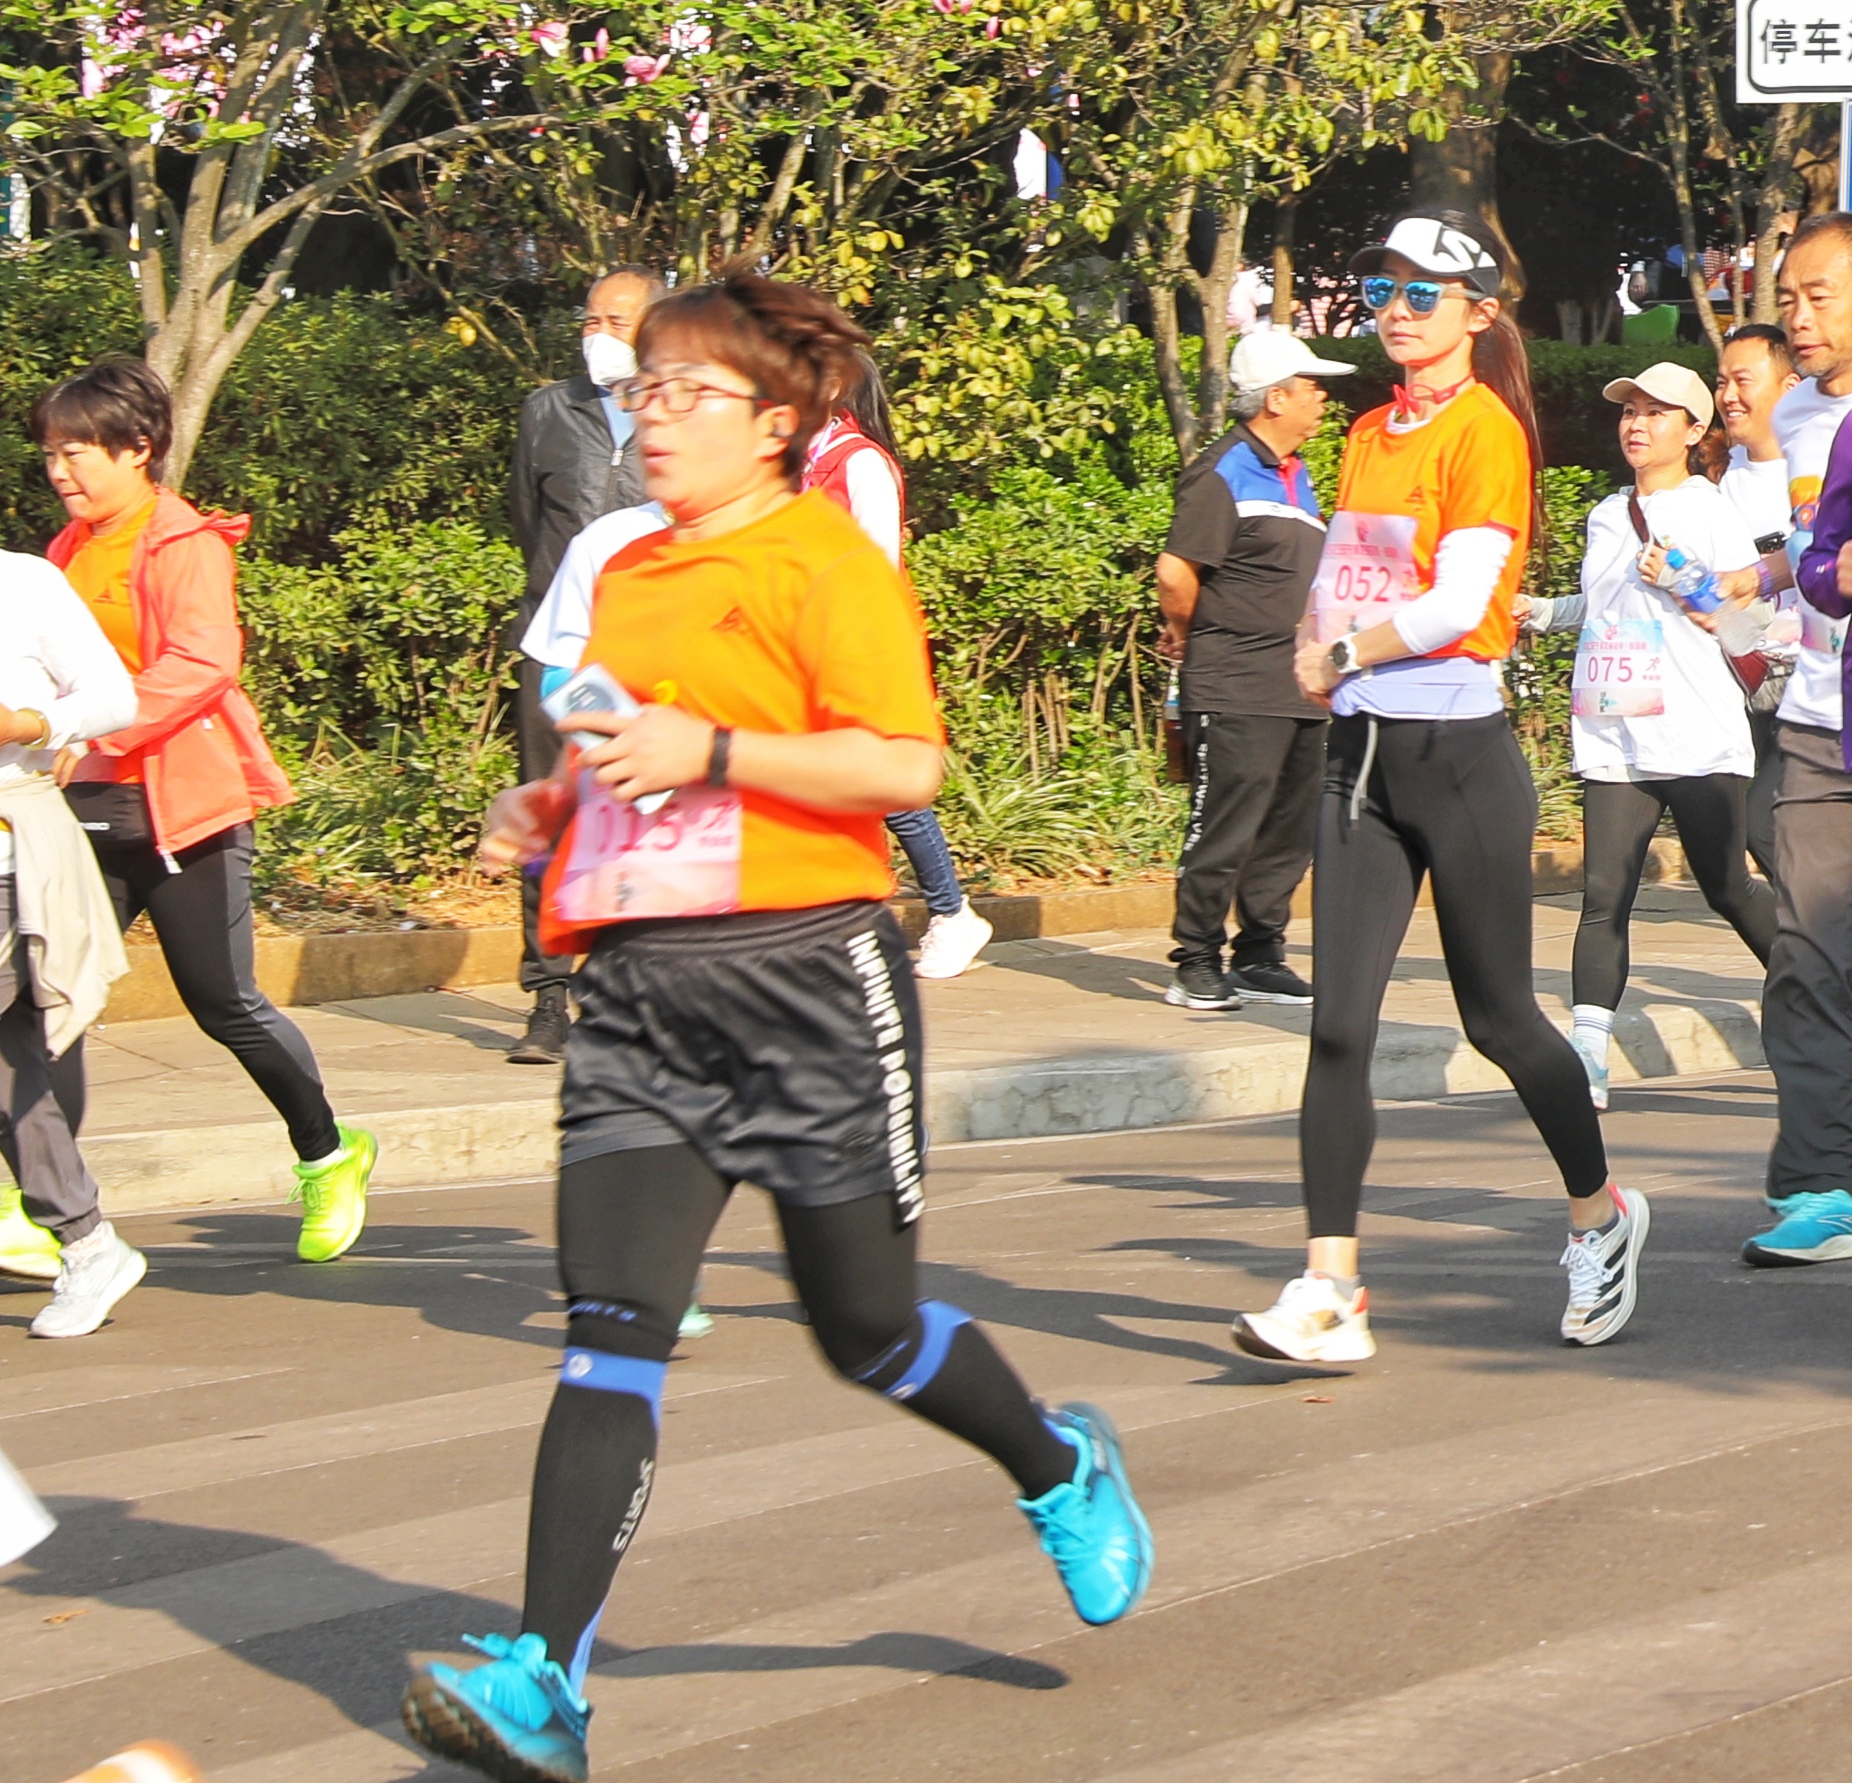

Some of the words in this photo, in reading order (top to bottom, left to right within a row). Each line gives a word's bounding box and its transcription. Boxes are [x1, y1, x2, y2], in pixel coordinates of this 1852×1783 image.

[1334, 564, 1391, 603] 052
[1587, 656, 1633, 683] 075
[847, 930, 904, 1049] INFINITE
[878, 1048, 926, 1223] POSSIBILITY
